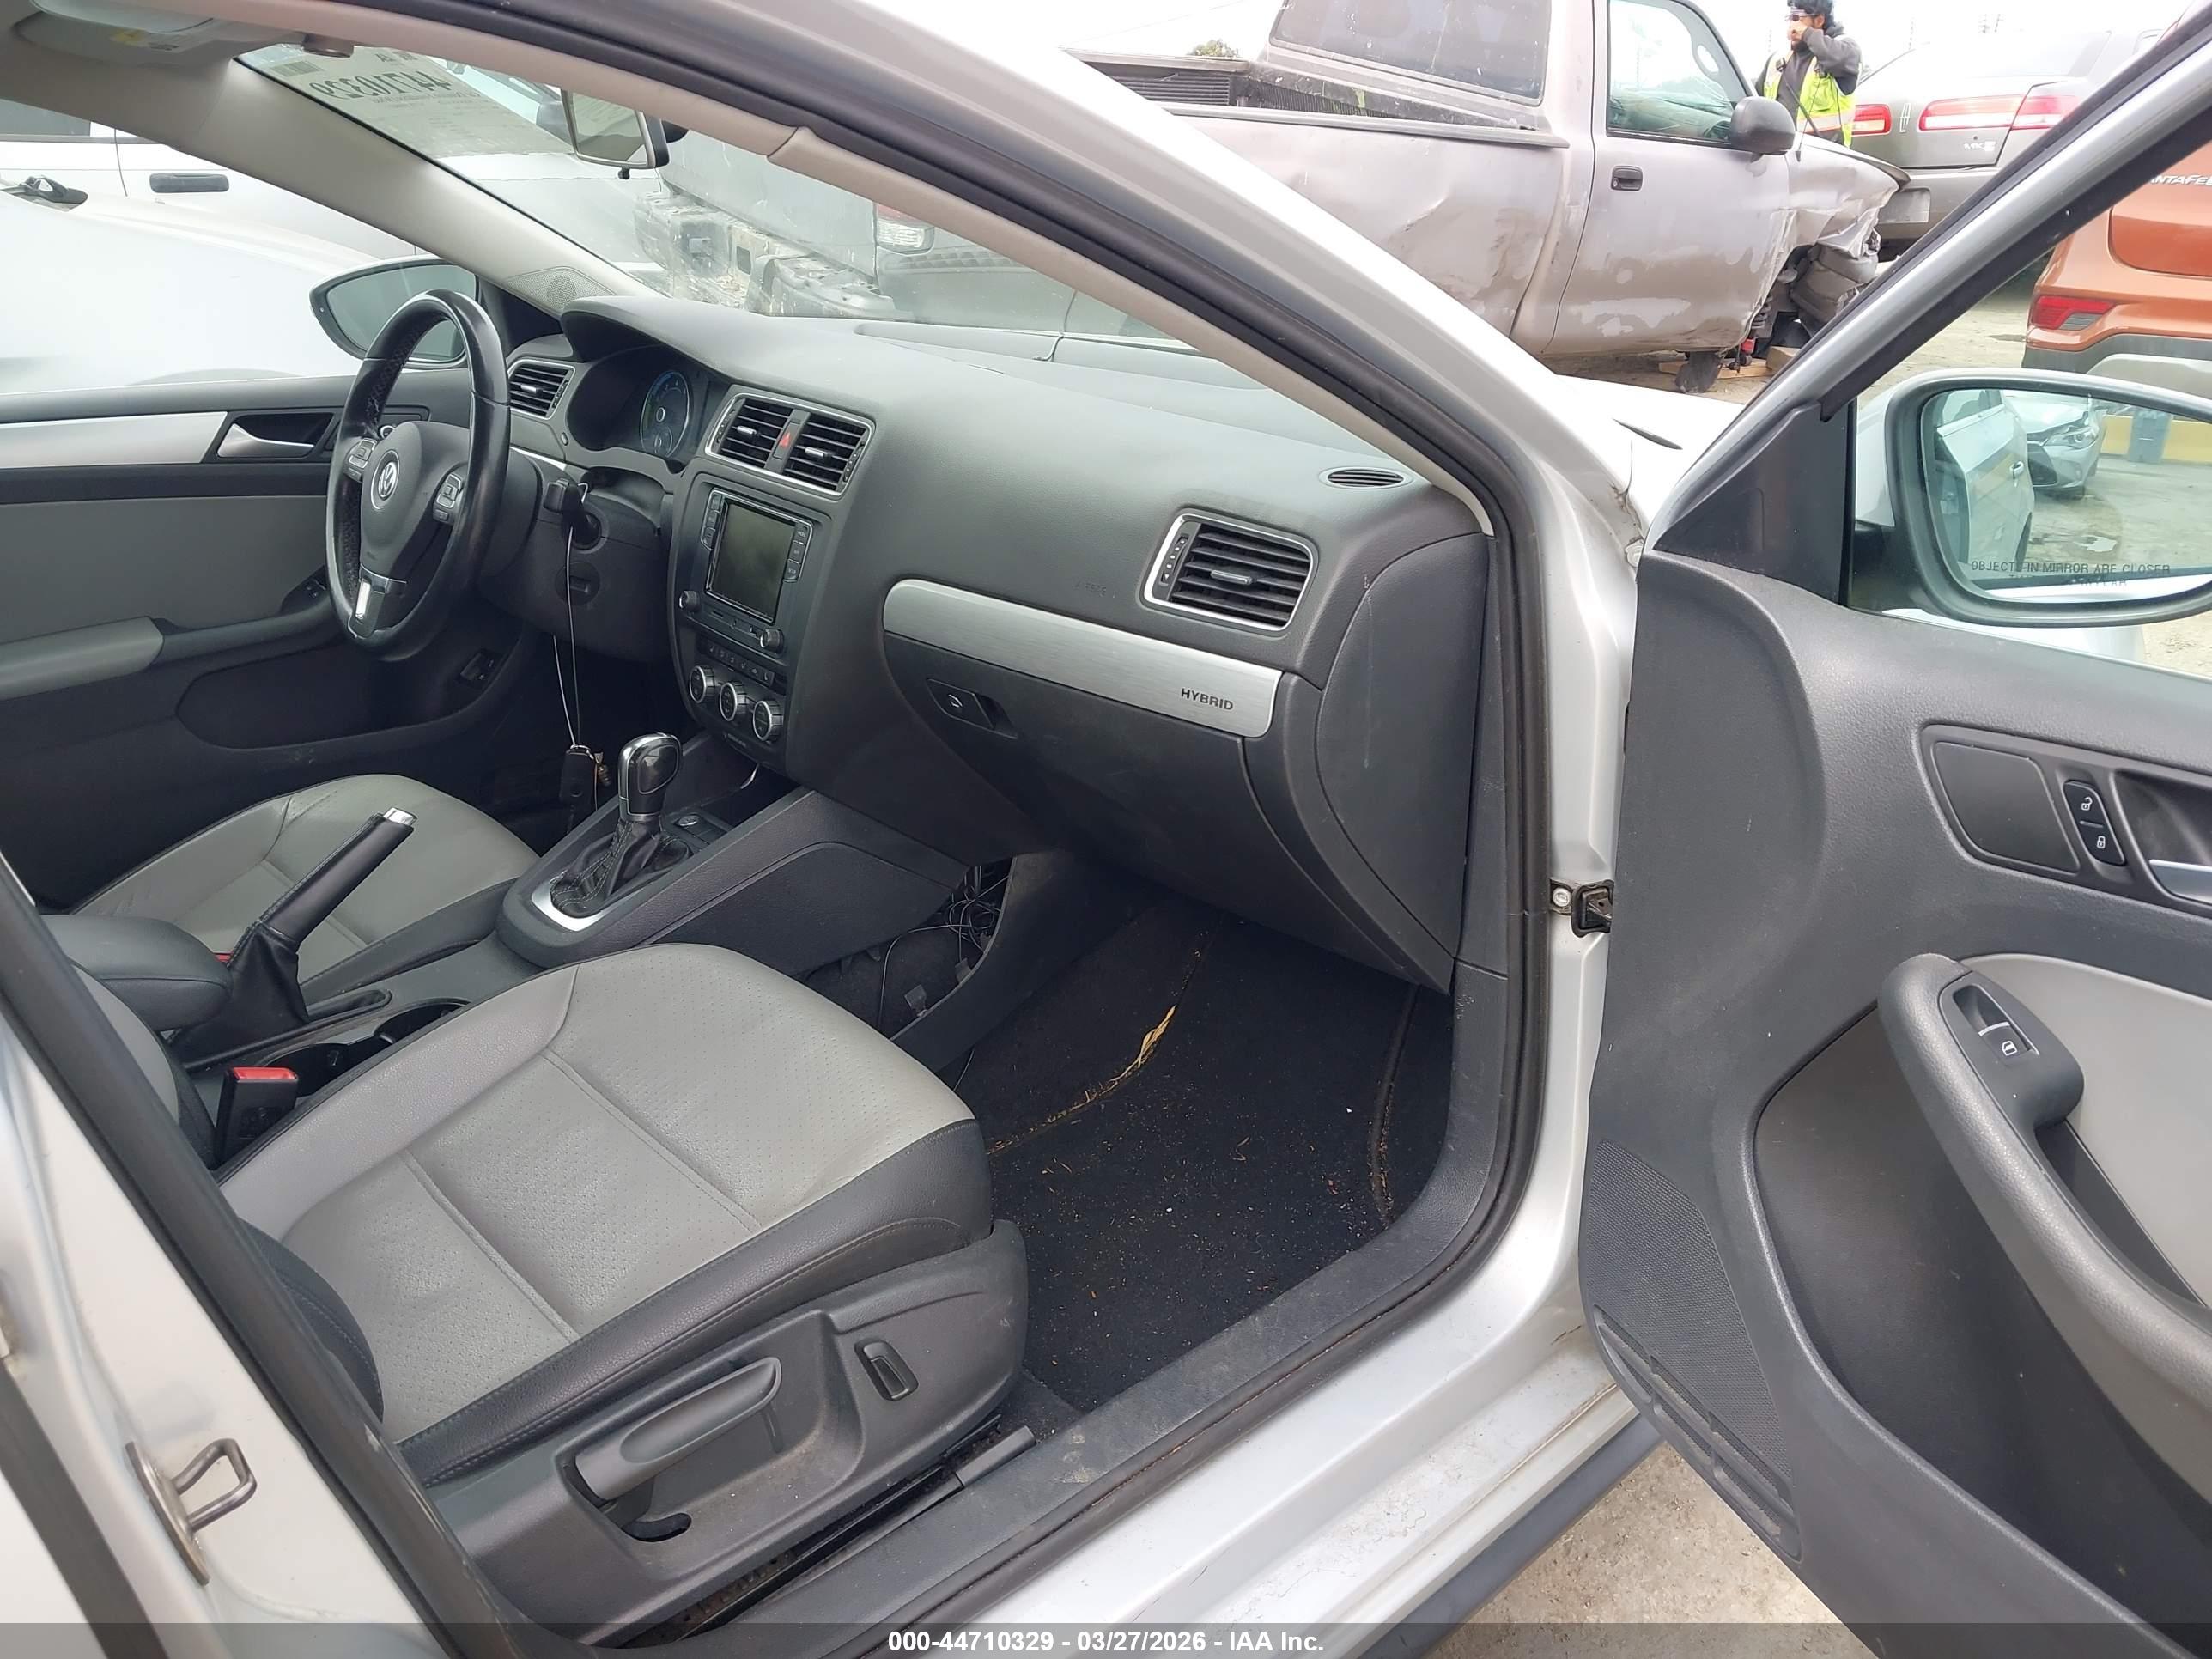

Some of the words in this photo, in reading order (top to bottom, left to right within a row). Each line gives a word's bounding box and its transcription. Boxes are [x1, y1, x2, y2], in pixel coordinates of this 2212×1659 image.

[1971, 561, 2023, 572] OBJECT
[2027, 562, 2039, 573] IN
[2042, 562, 2089, 574] MIRROR
[2094, 563, 2117, 574] ARE
[1181, 687, 1233, 710] HYBRID
